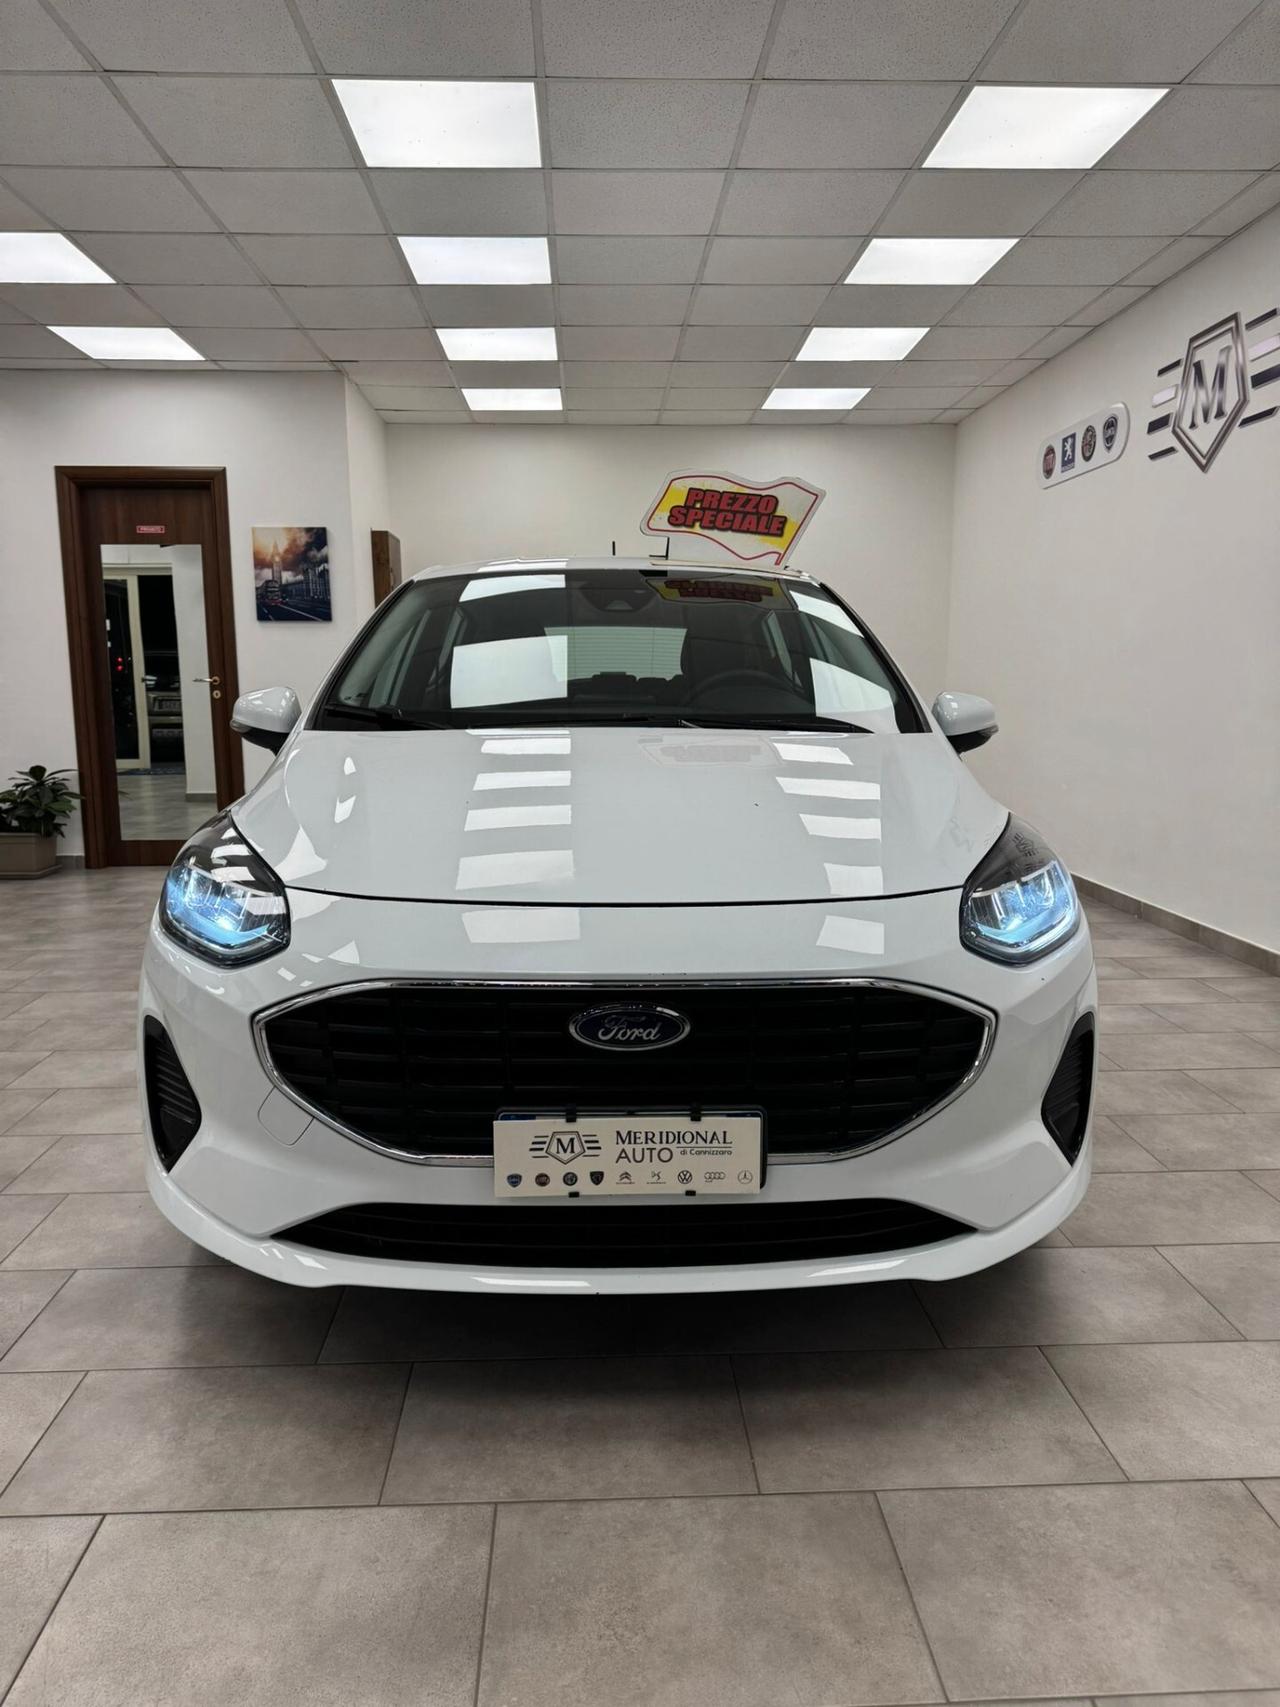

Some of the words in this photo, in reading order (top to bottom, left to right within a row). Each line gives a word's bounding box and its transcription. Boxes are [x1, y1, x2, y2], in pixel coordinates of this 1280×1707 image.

[1189, 346, 1232, 430] M
[686, 489, 778, 513] PREZZO
[669, 507, 786, 535] SPECIALE
[597, 1015, 661, 1041] Ford
[556, 1137, 576, 1155] M
[615, 1130, 733, 1145] MERIDIONAL
[615, 1147, 674, 1164] AUTO
[680, 1148, 688, 1156] di
[689, 1148, 733, 1156] Cannizzaro
